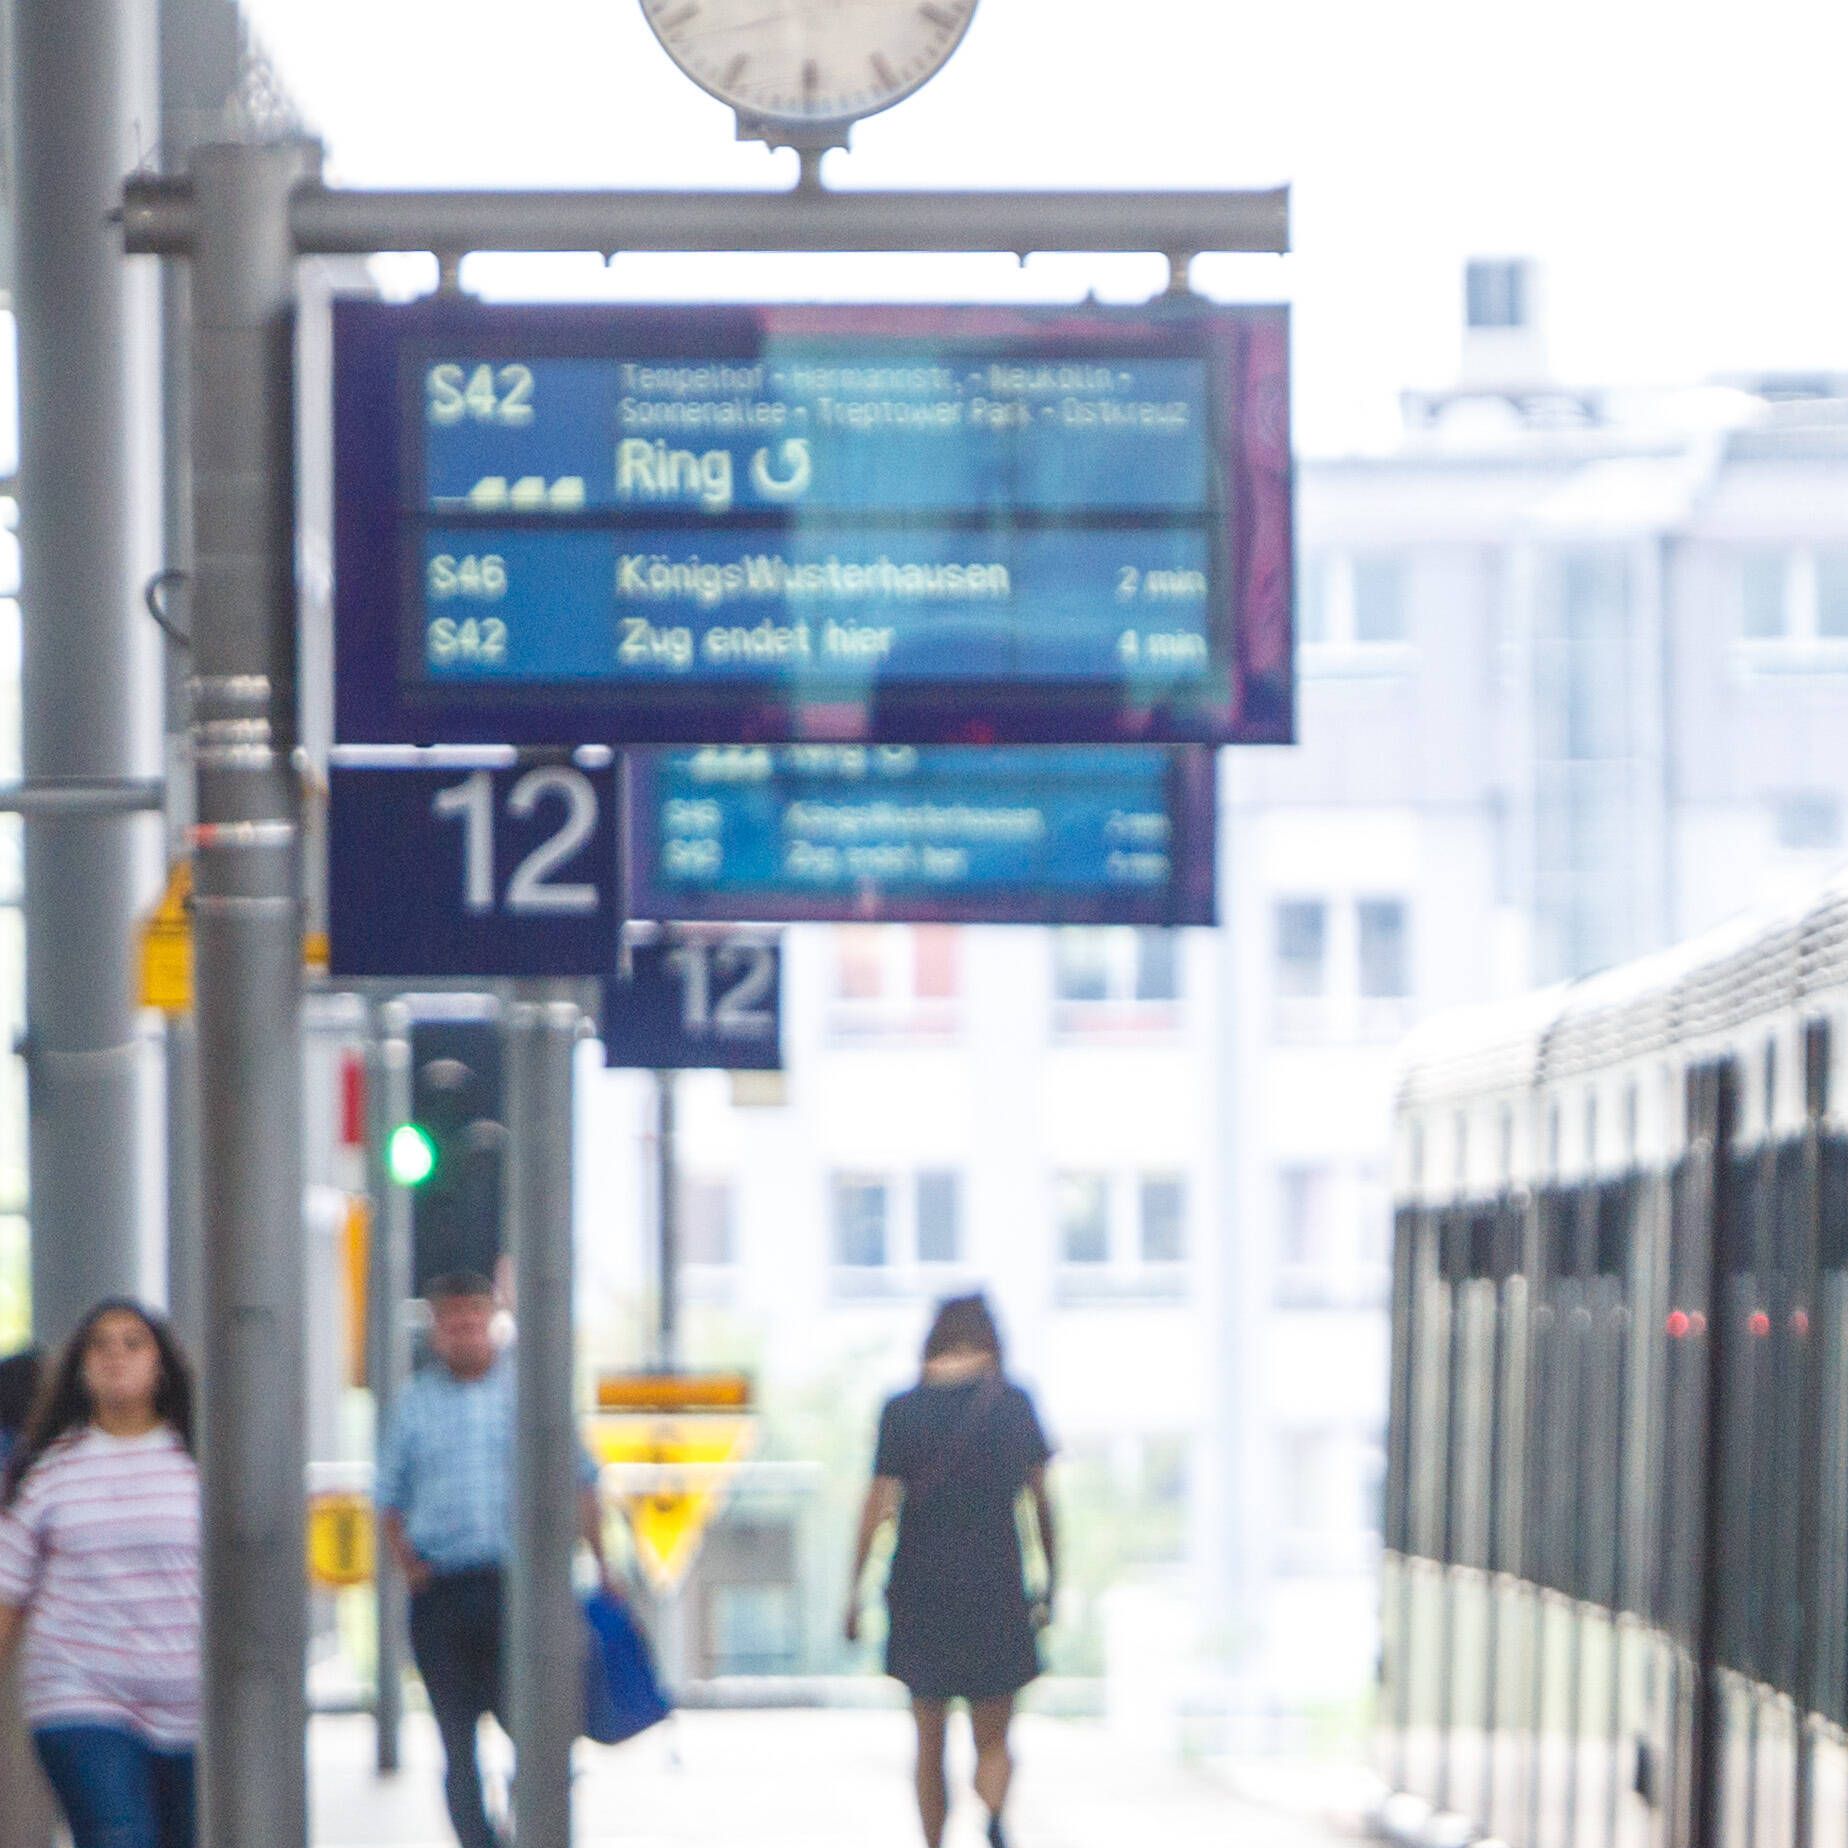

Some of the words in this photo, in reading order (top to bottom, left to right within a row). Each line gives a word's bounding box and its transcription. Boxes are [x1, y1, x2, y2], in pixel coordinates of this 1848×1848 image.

[428, 363, 534, 424] S42
[619, 363, 764, 394] Tempelhof
[619, 397, 787, 428] Sonnenallee
[616, 437, 733, 512] Ring
[428, 553, 508, 598] S46
[1143, 566, 1209, 600] min
[428, 616, 508, 664] S42
[617, 616, 693, 674] Zug
[702, 616, 813, 660] endet
[822, 616, 897, 660] hier
[1144, 628, 1209, 665] min
[434, 765, 598, 912] 12
[667, 938, 776, 1036] 12
